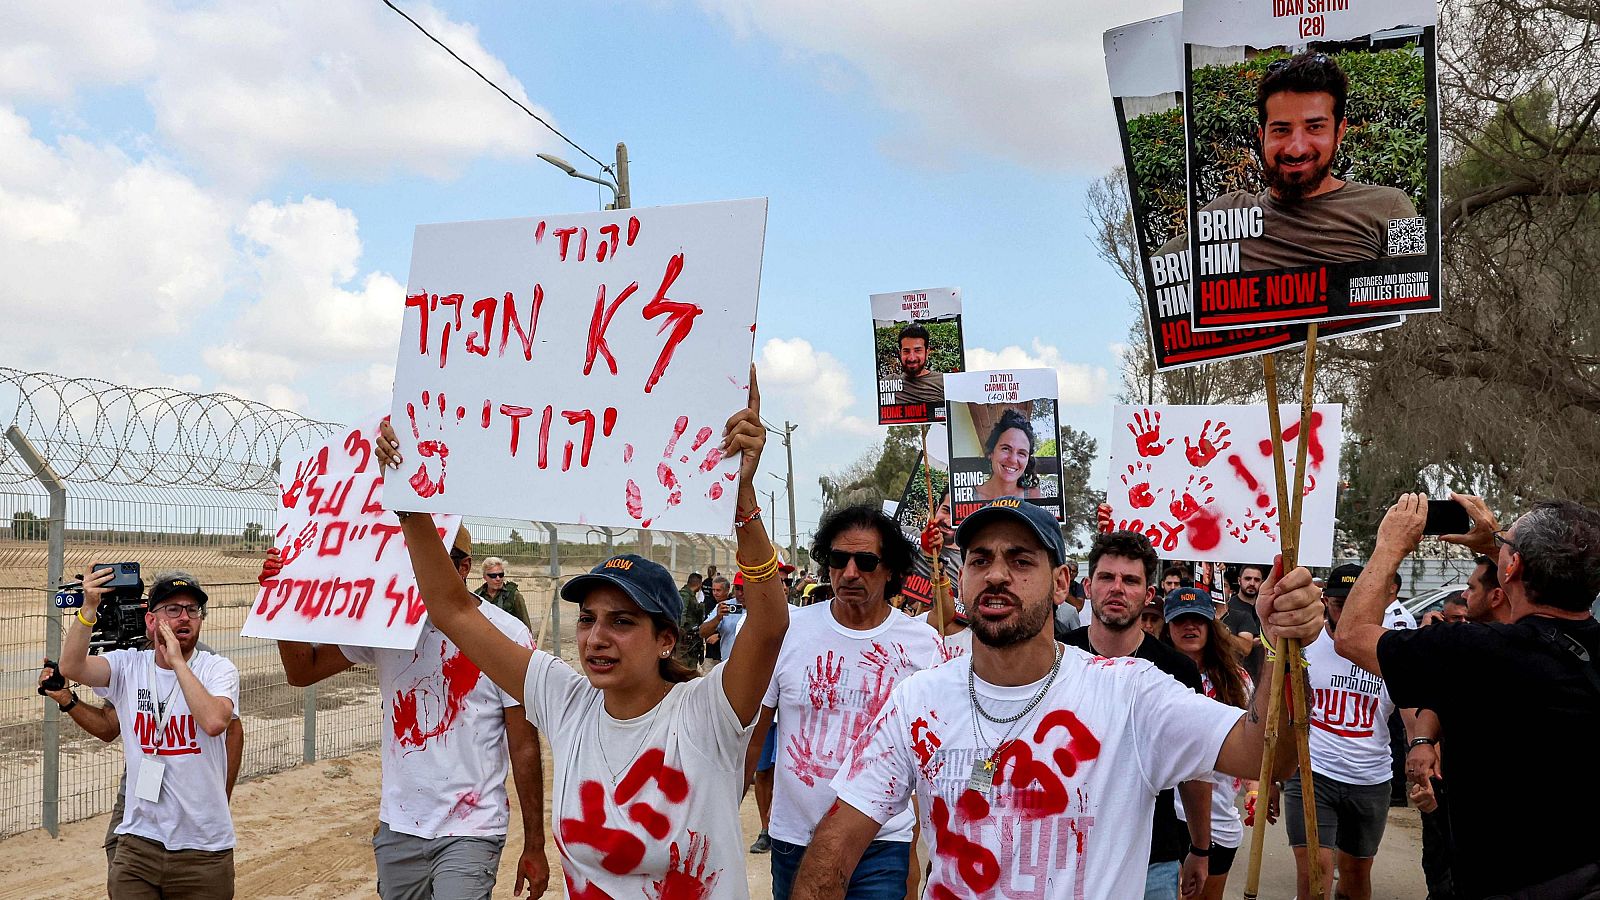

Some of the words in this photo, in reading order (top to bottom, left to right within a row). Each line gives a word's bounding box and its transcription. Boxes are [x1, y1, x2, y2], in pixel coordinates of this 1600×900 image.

[1299, 15, 1325, 39] (28)
[1198, 206, 1264, 242] BRING
[535, 216, 641, 262] יהודי
[1199, 242, 1240, 276] HIM
[1349, 275, 1383, 289] HOSTAGES
[1383, 274, 1398, 285] AND
[1398, 271, 1429, 284] MISSING
[1200, 277, 1261, 312] HOME
[1266, 266, 1328, 307] NOW!
[1350, 285, 1392, 303] FAMILIES
[1394, 282, 1429, 299] FORUM
[405, 284, 544, 369] מפקיר
[583, 252, 704, 393] לא
[880, 379, 903, 392] BRING
[984, 383, 1007, 392] CARMEL
[1008, 382, 1020, 391] GAT
[880, 392, 896, 405] HIM
[881, 405, 904, 418] HOME
[905, 402, 927, 417] NOW!
[480, 400, 618, 472] יהודי
[953, 471, 984, 487] BRING
[954, 487, 974, 502] HER
[991, 499, 1021, 508] NOW
[604, 558, 633, 570] NOW
[1180, 593, 1196, 601] NOW
[1331, 674, 1359, 690] הביתה
[1360, 680, 1382, 695] אותם
[134, 711, 197, 748] NOW!
